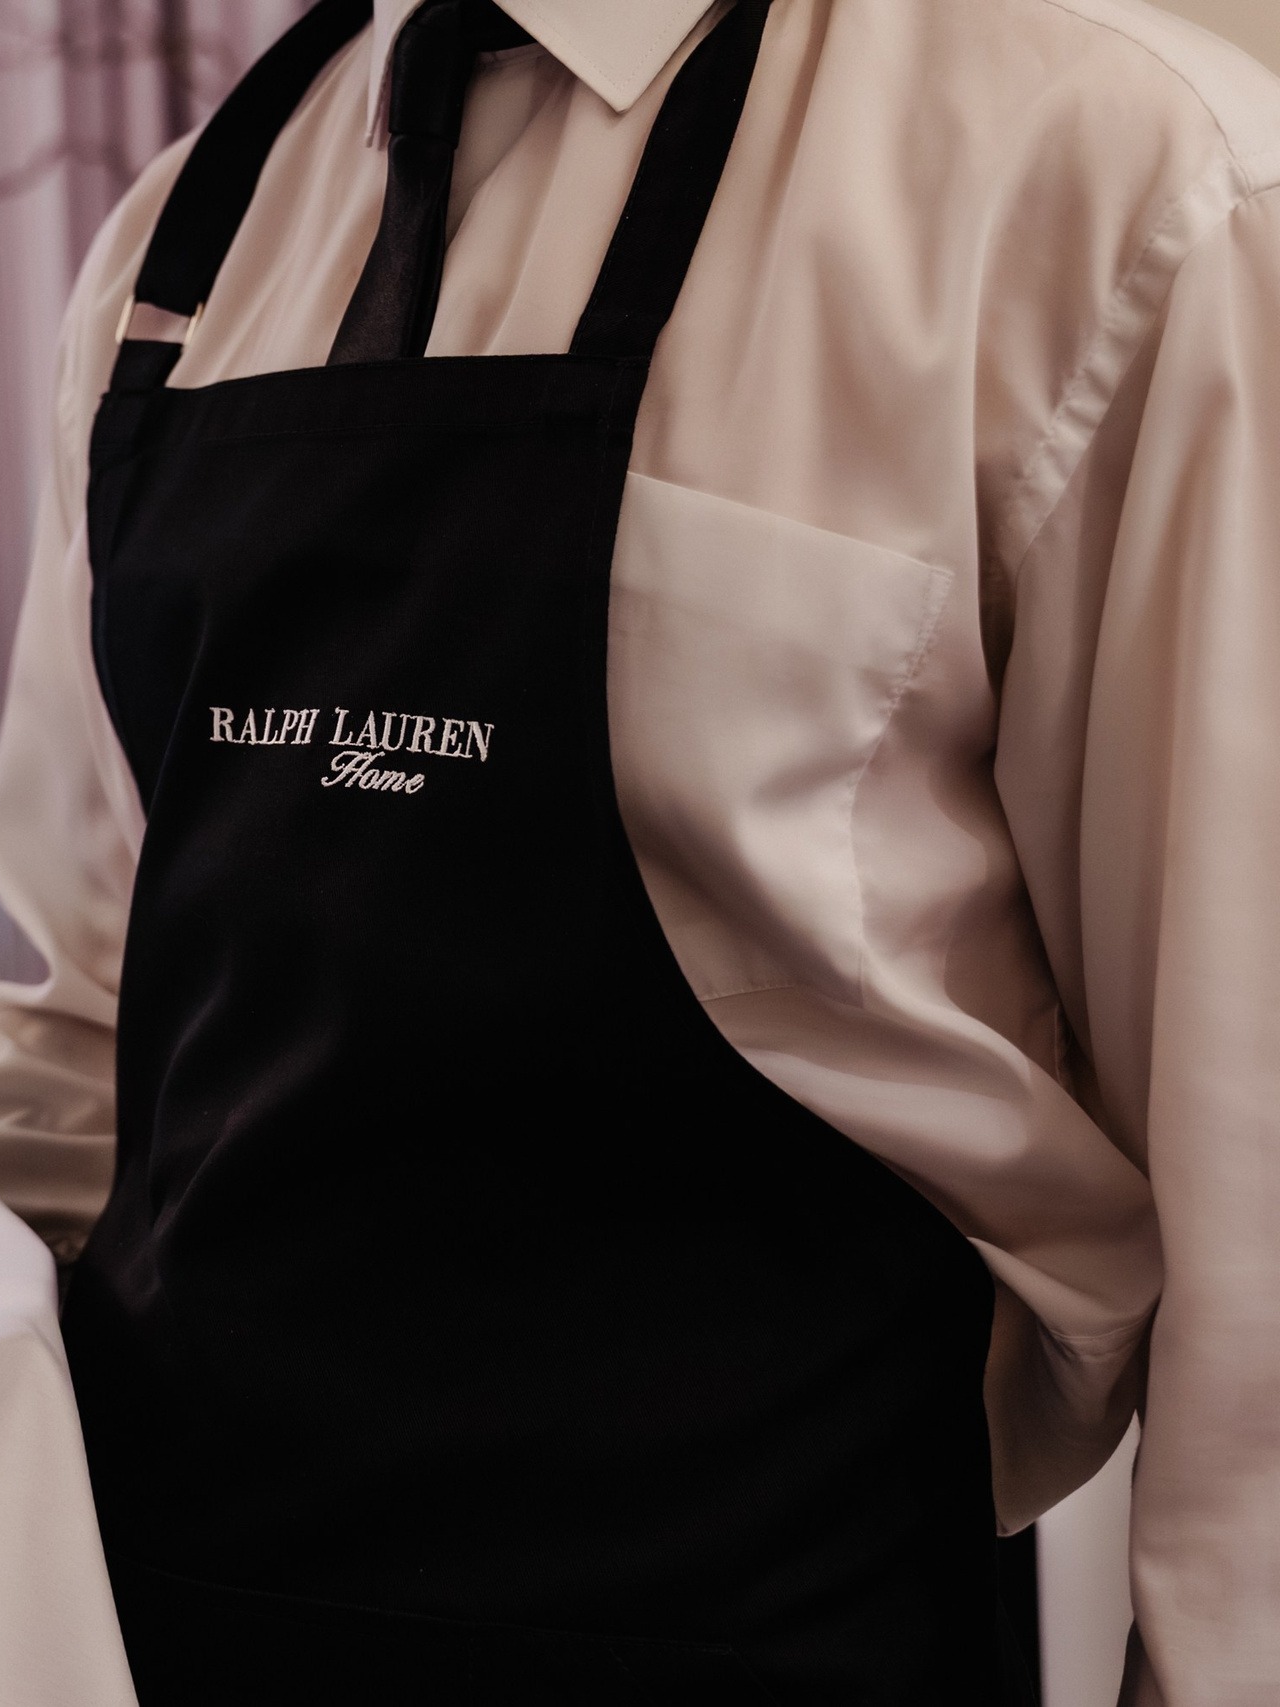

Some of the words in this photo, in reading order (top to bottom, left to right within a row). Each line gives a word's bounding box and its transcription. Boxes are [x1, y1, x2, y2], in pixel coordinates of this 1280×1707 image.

[209, 706, 321, 746] RALPH
[328, 706, 495, 762] LAUREN
[320, 750, 425, 795] Home
